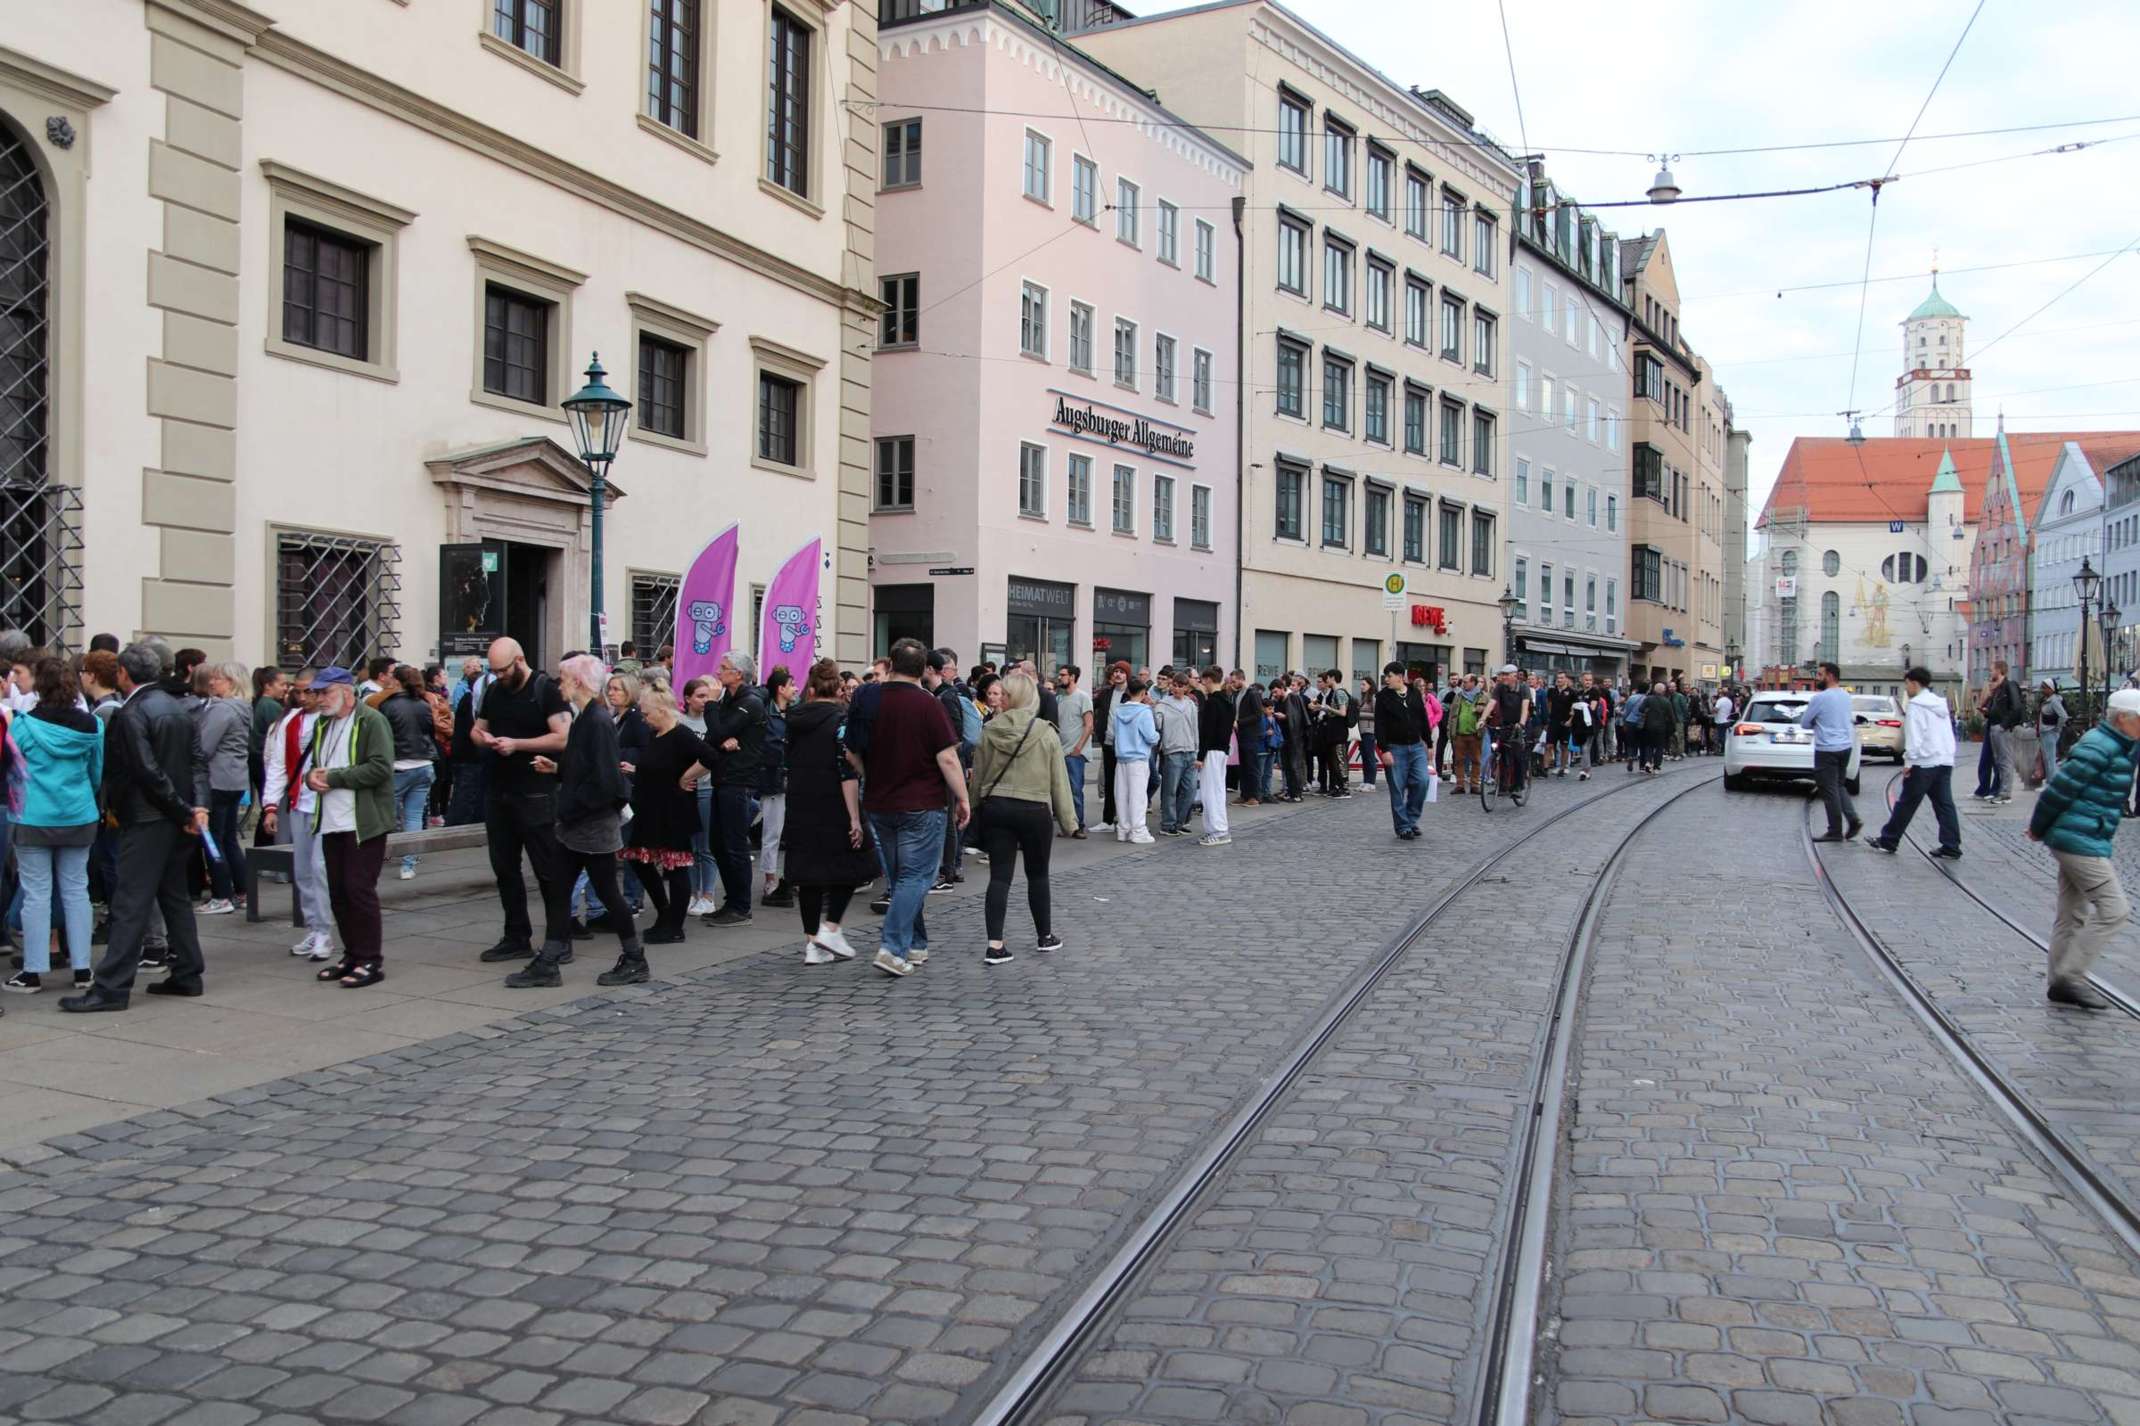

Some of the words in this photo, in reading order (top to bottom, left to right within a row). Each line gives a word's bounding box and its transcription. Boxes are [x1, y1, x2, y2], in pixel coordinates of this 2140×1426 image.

[1054, 397, 1130, 443] Augsburger
[1131, 419, 1194, 458] Allgemeine
[1891, 521, 1902, 531] W
[1412, 605, 1445, 626] REWE
